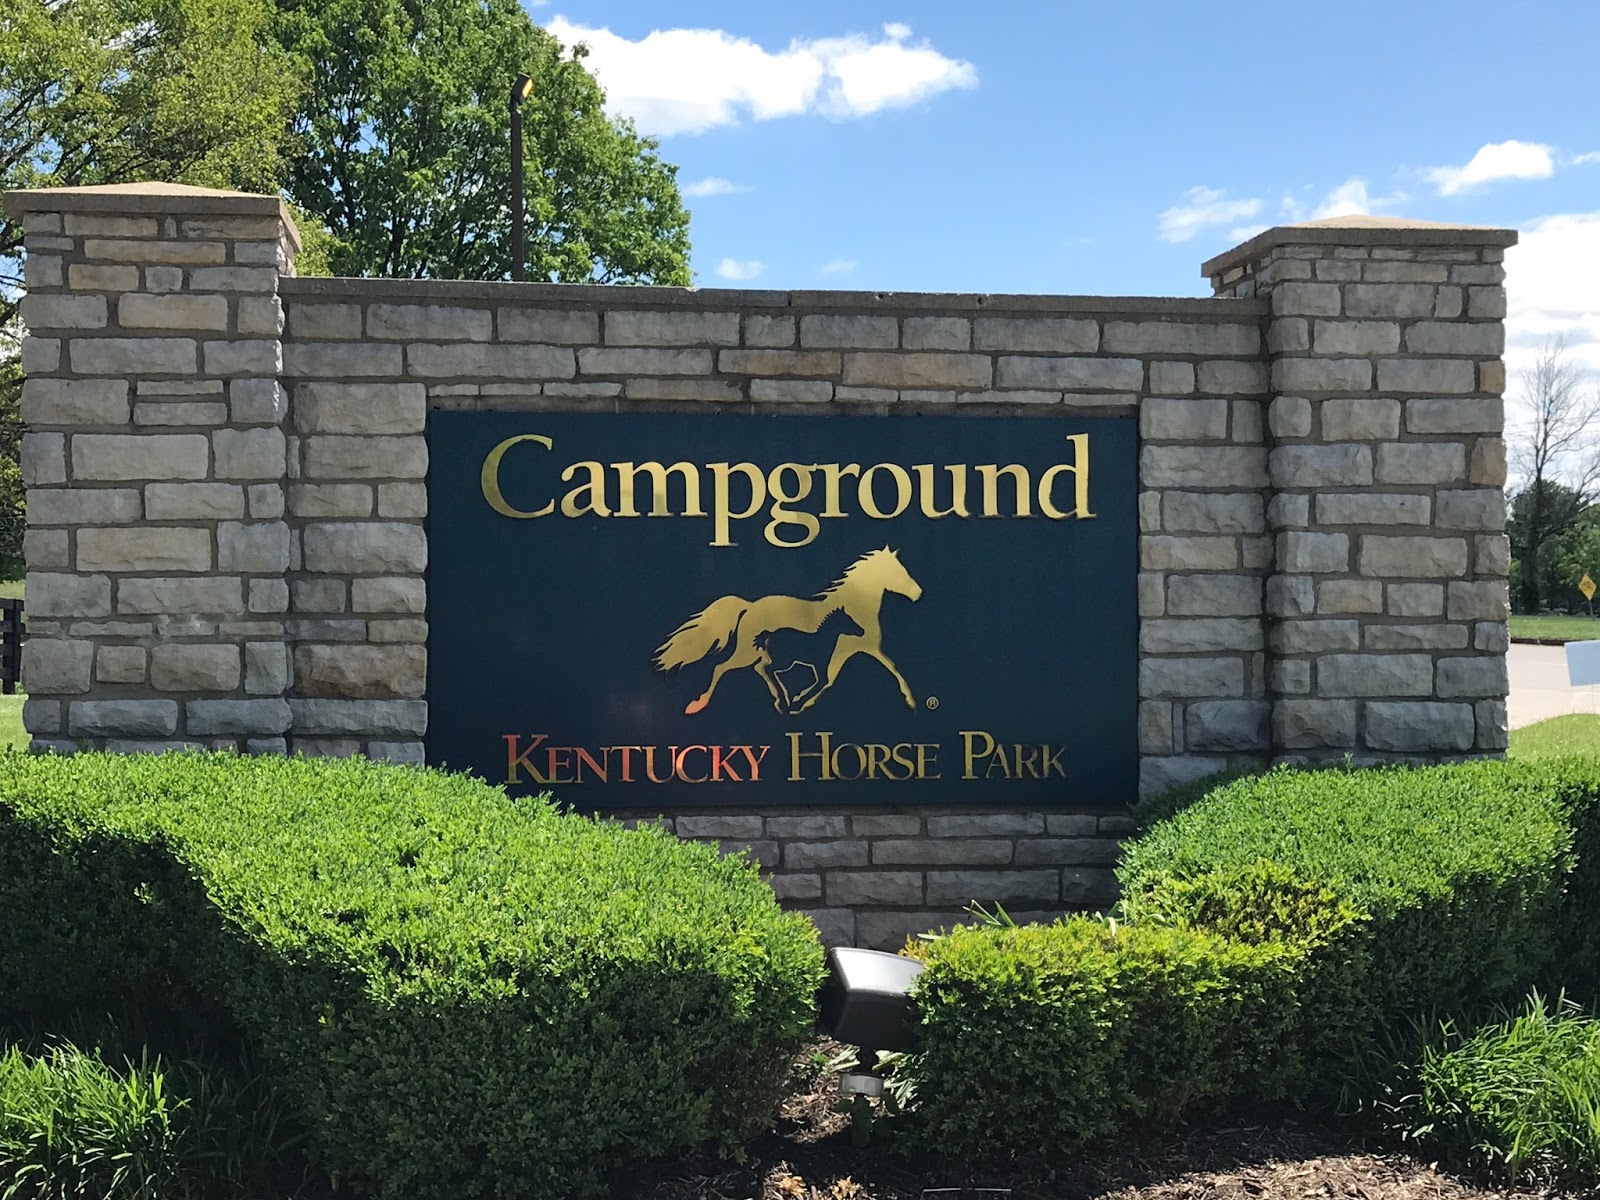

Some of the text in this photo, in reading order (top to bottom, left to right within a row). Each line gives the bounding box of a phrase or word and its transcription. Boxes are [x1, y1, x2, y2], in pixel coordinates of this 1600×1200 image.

[480, 433, 1096, 548] Campground
[502, 730, 1068, 784] KENTUCKY HORSE PARK
